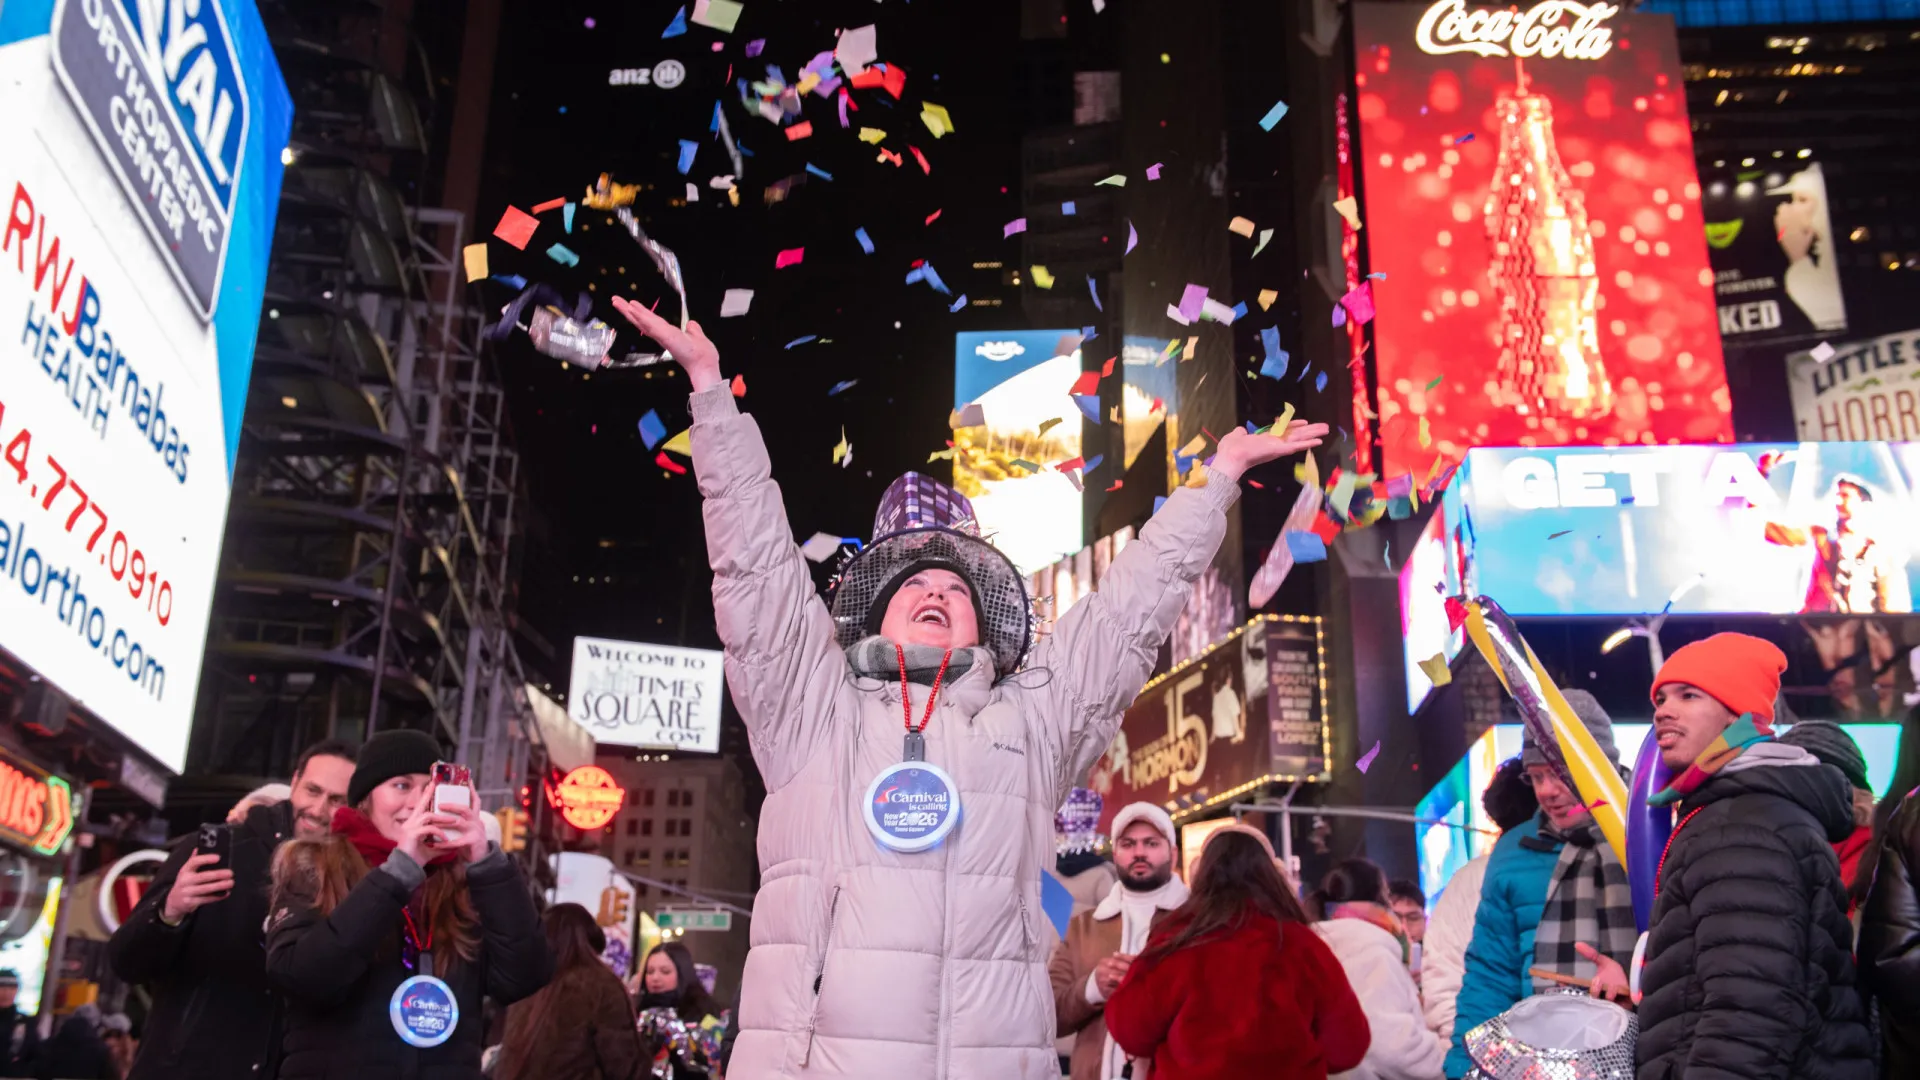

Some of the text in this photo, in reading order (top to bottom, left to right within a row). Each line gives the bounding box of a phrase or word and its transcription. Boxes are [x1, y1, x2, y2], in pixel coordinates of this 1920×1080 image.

[1415, 0, 1619, 60] Coca-Cola
[608, 67, 651, 86] anz
[80, 0, 218, 252] ORTHOPAEDIC
[110, 96, 185, 241] CENTER
[3, 180, 190, 484] RWJBarnabas
[1718, 299, 1782, 336] KED
[22, 300, 111, 440] HEALTH
[1811, 340, 1908, 397] LITTLE
[1816, 389, 1920, 442] HORR
[1502, 452, 1672, 510] GET
[0, 403, 172, 627] 4.777.0910
[587, 643, 706, 670] WELCOME TO
[633, 673, 705, 700] TIMES
[579, 690, 706, 731] SQUARE
[656, 730, 702, 745] COM
[890, 791, 948, 803] Carnival
[909, 803, 947, 812] is calling
[899, 811, 938, 826] 2026
[412, 1000, 451, 1012] Carnival
